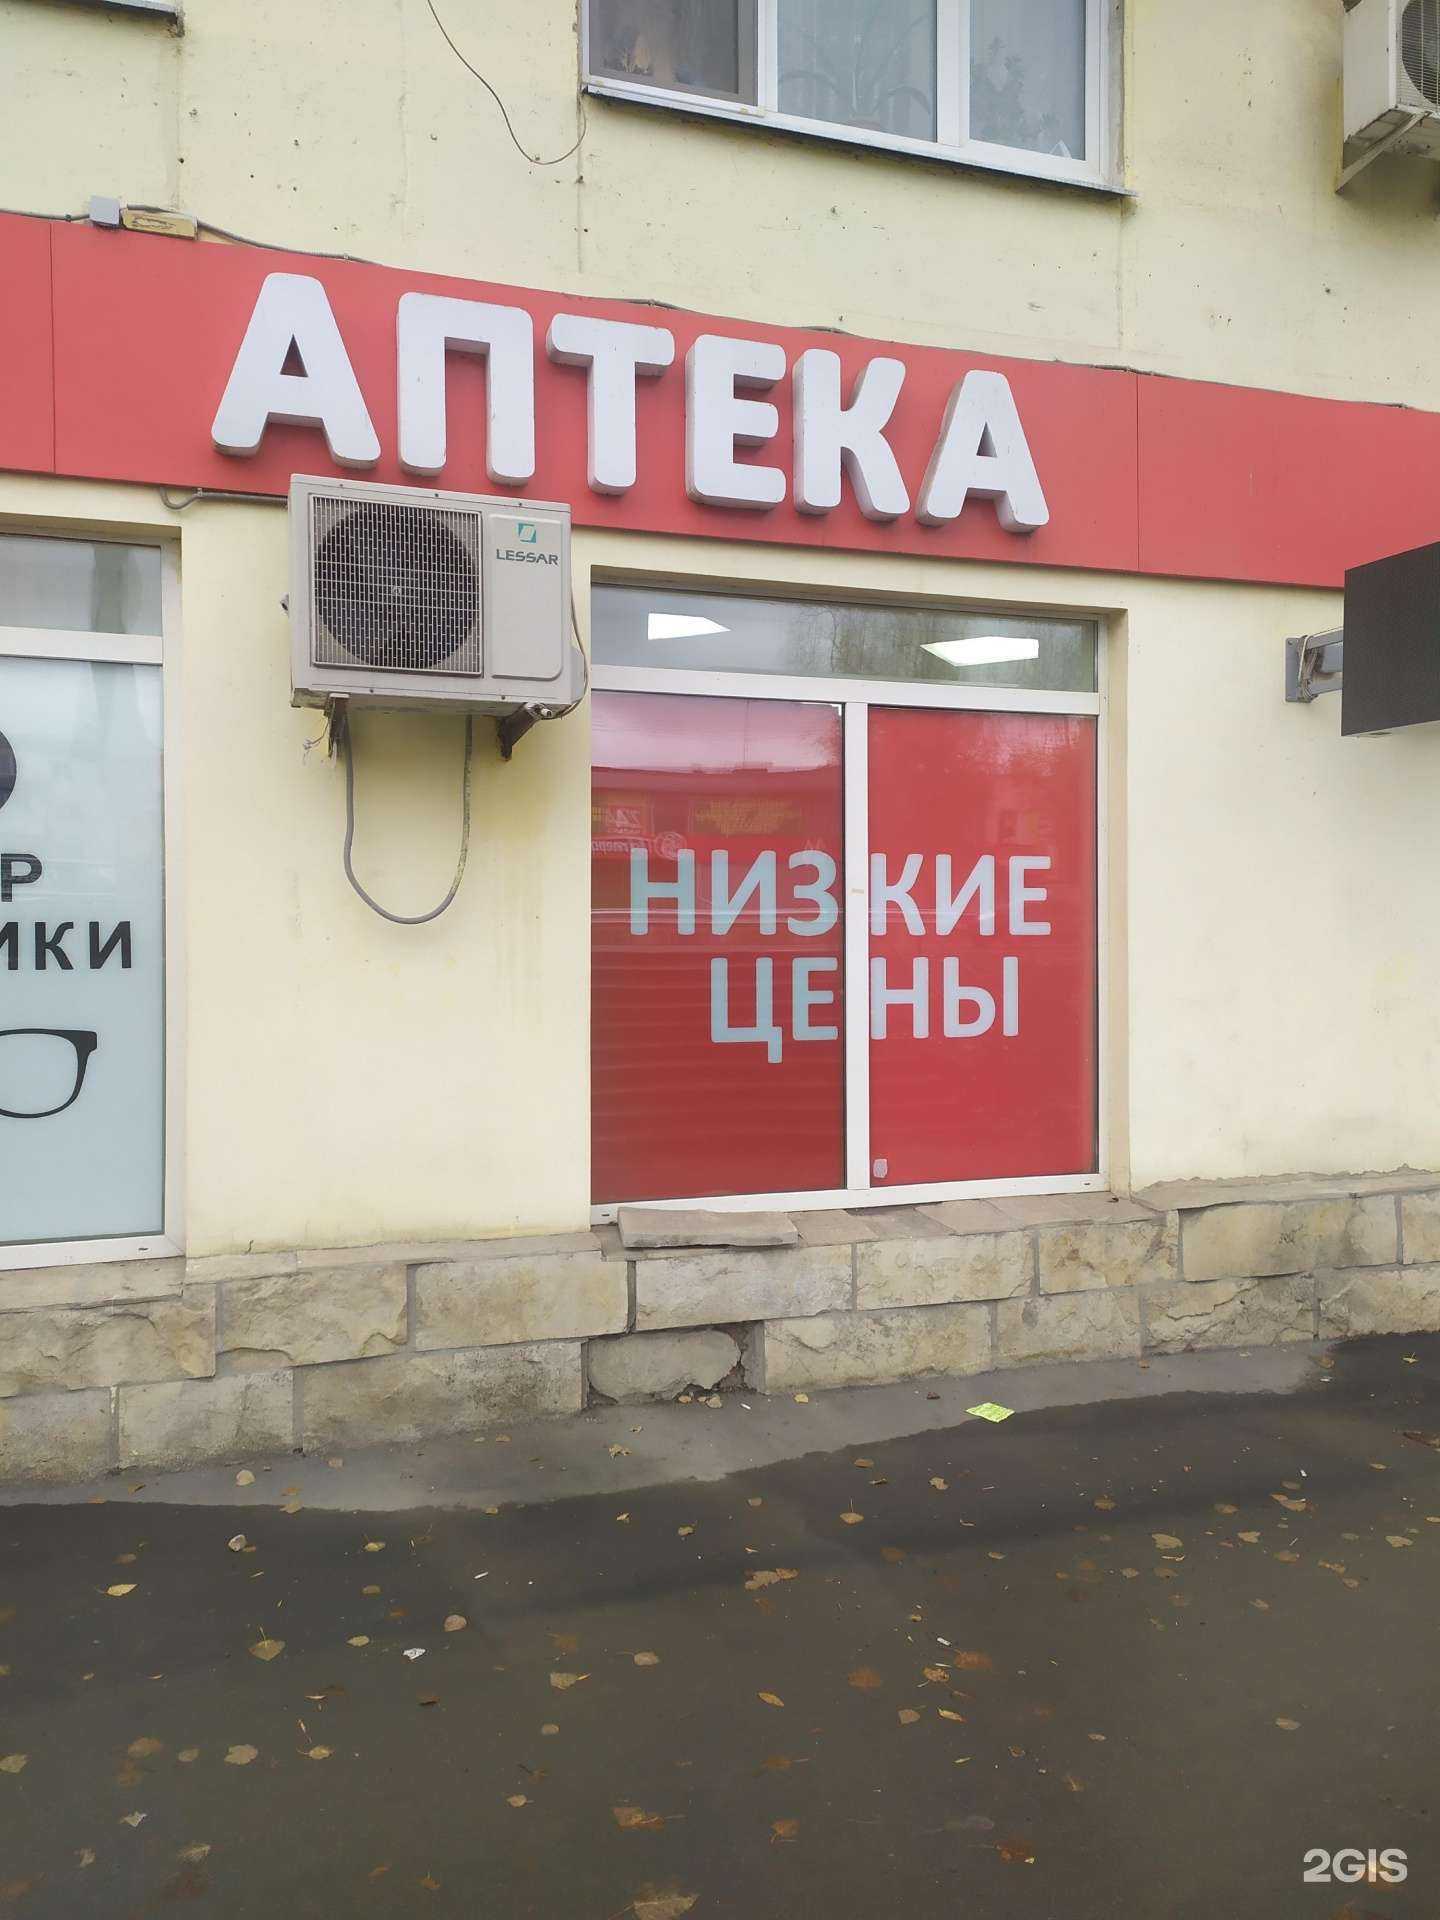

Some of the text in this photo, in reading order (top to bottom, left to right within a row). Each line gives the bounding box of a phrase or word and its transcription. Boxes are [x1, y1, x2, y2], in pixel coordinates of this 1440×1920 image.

[211, 272, 1051, 534] АПТЕКА
[496, 548, 559, 566] LESSAR
[629, 848, 1052, 937] НИЗКИЕ
[710, 956, 1019, 1064] ЦЕНЫ
